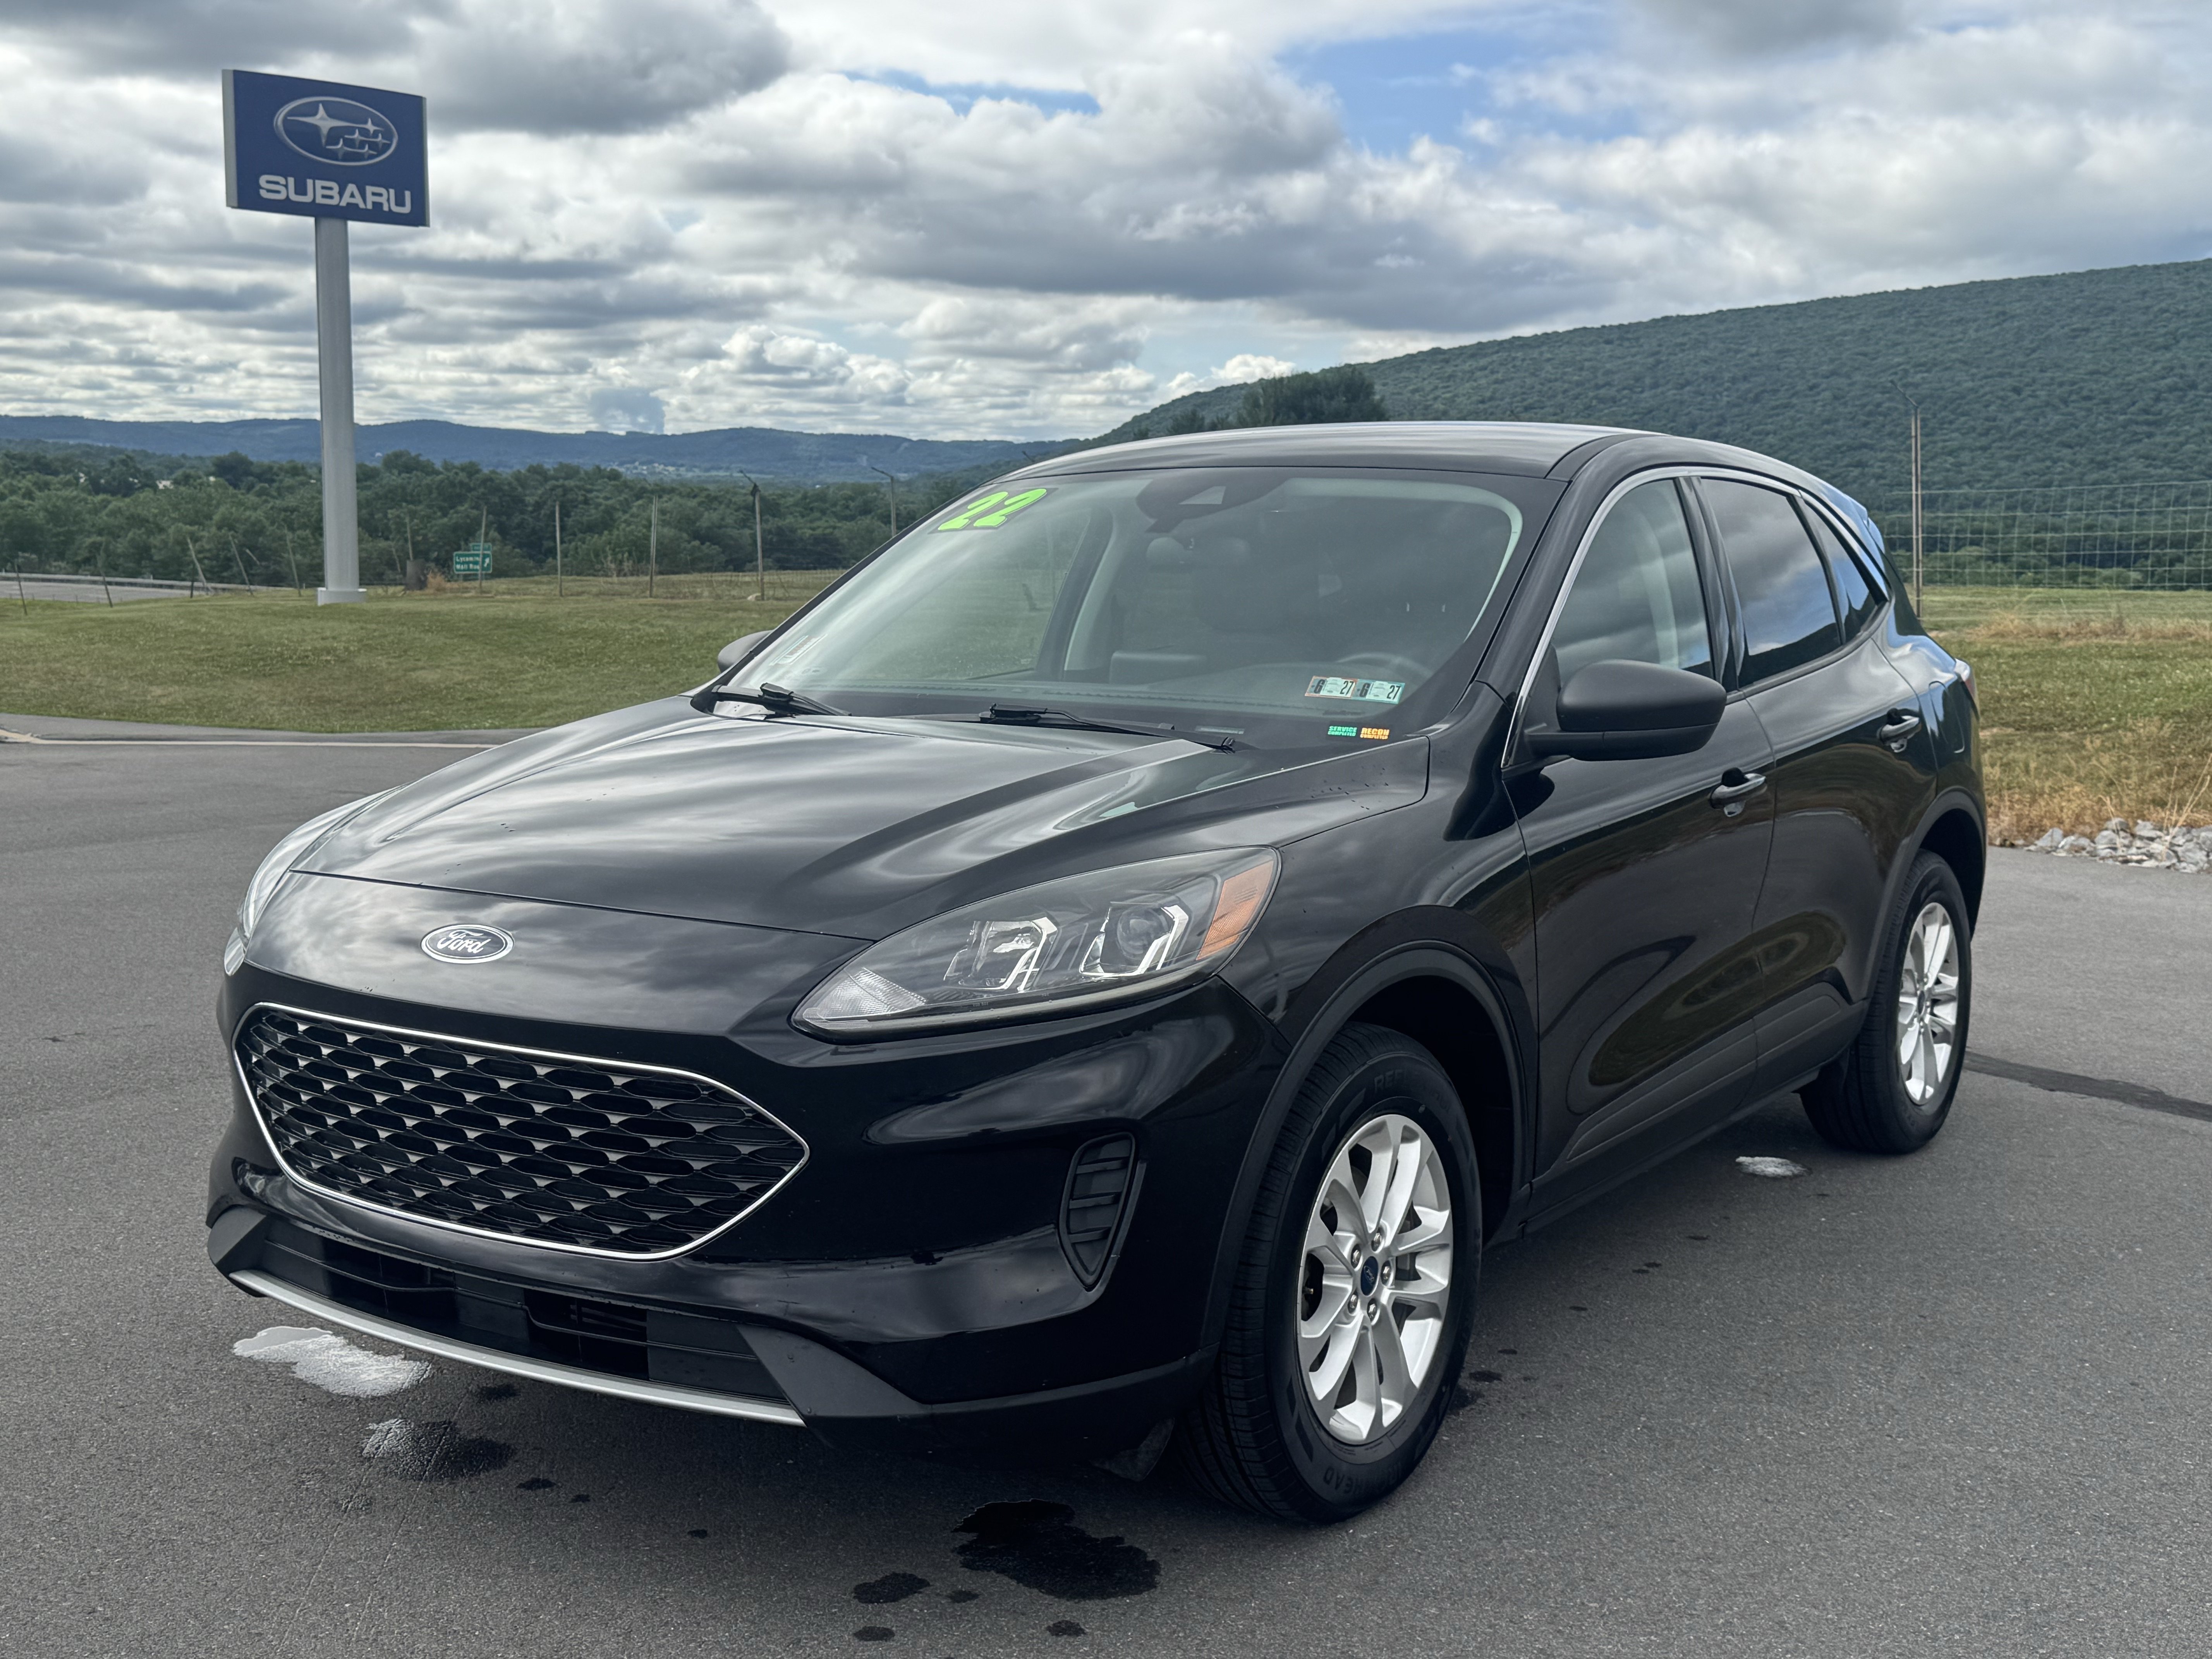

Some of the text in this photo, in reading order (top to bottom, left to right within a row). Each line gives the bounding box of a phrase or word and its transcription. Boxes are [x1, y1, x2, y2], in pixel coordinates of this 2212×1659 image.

[259, 175, 411, 213] SUBARU
[938, 489, 1047, 531] 22
[1314, 679, 1326, 694] 6
[1340, 680, 1354, 696] 27
[1360, 683, 1370, 697] 6
[1387, 685, 1401, 700] 27
[437, 930, 491, 953] Ford
